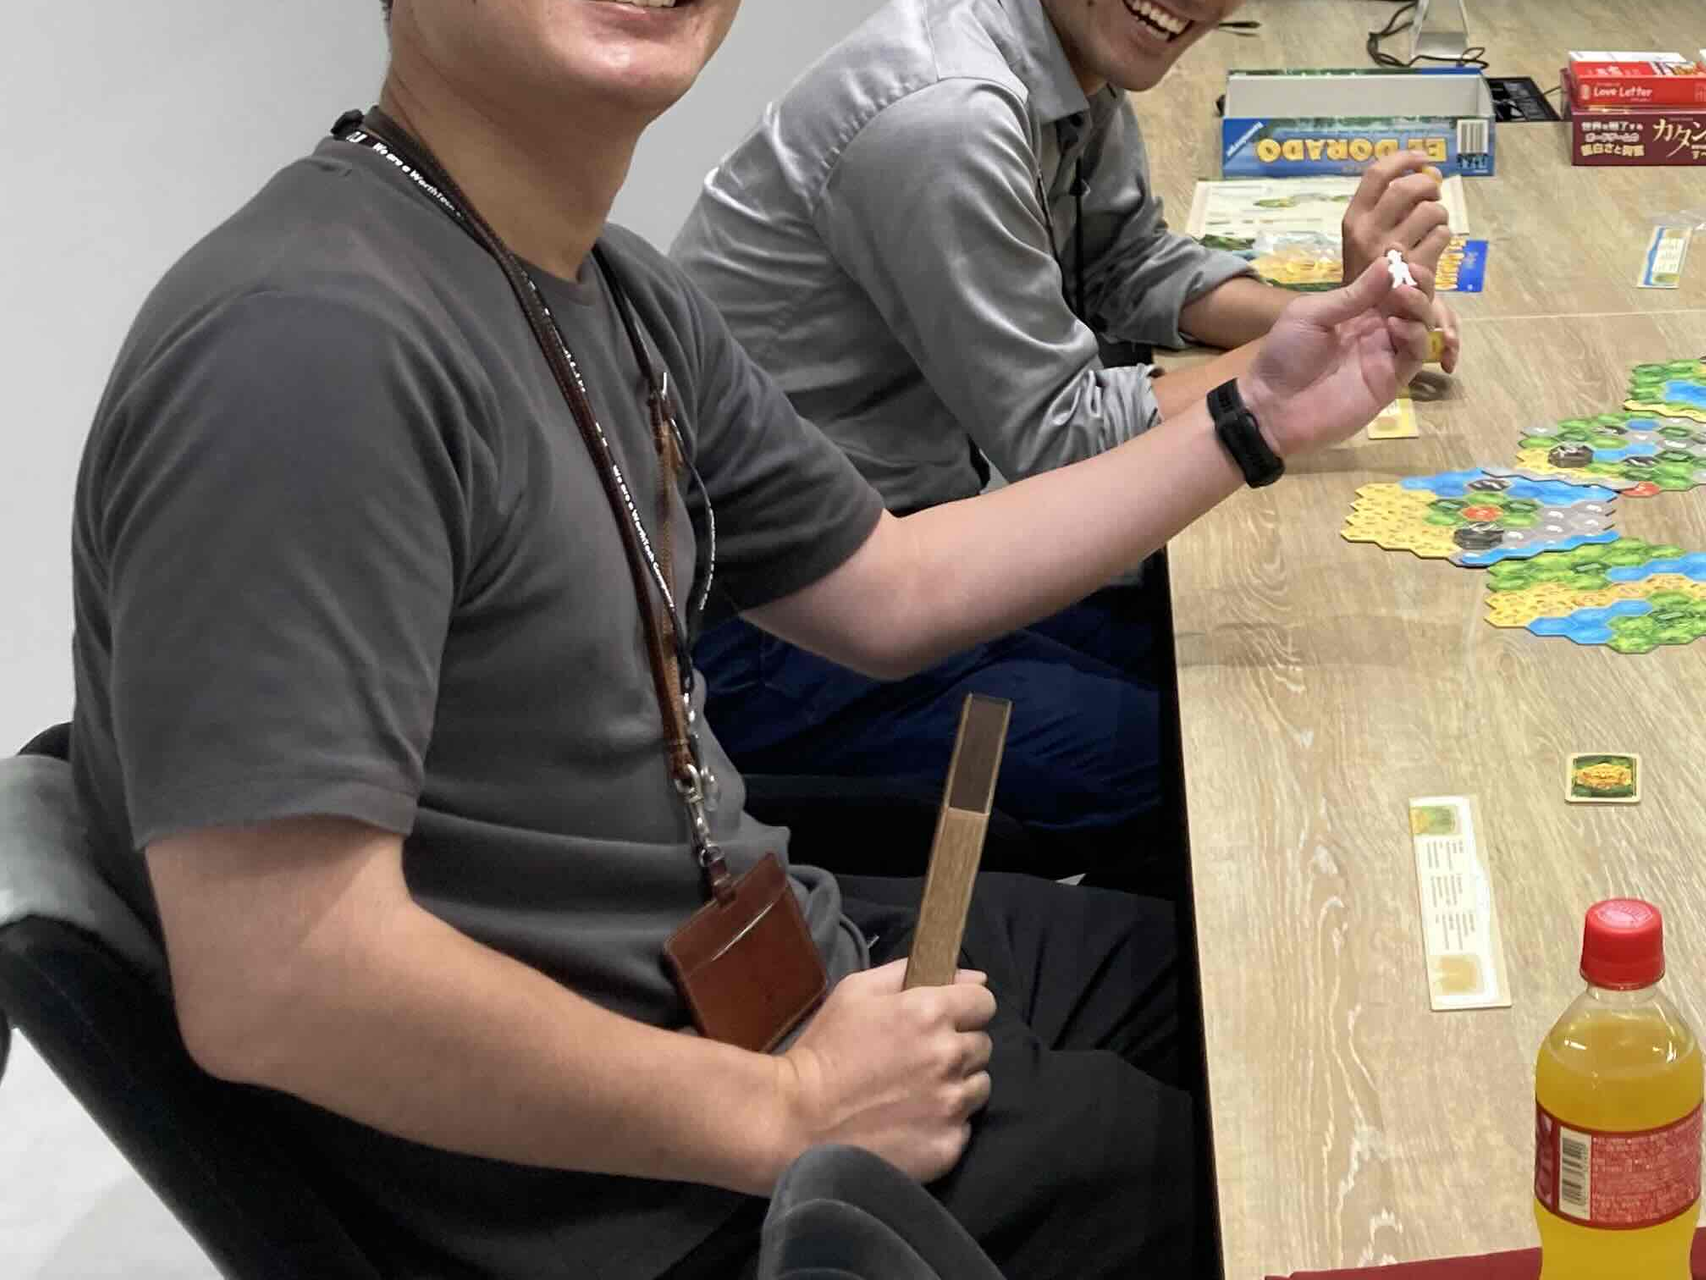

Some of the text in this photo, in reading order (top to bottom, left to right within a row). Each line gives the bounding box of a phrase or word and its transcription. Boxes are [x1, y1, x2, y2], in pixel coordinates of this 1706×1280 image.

[1594, 86, 1653, 97] Love Letter
[373, 142, 388, 155] We
[386, 153, 403, 166] are
